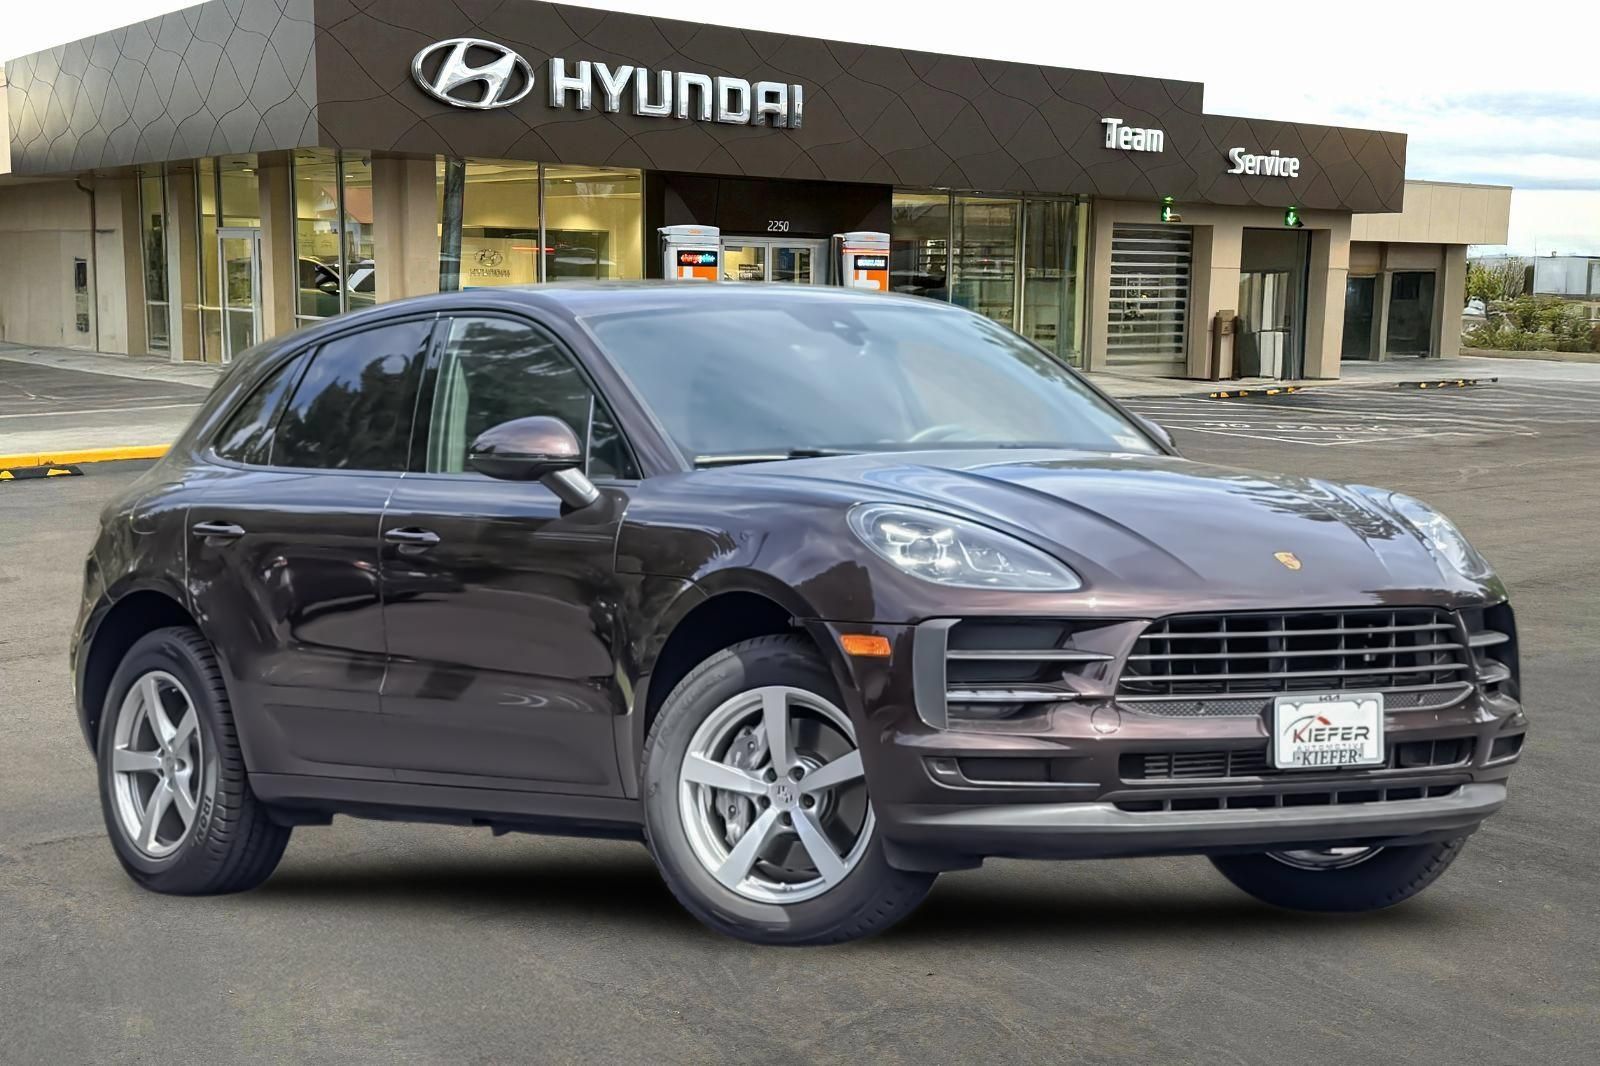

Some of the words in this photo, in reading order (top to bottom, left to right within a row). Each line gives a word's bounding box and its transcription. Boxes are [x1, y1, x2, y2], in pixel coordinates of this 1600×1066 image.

[549, 57, 803, 129] HYUNDAI
[1101, 117, 1164, 153] Team
[1228, 147, 1300, 178] Service
[767, 220, 790, 232] 2250
[1292, 726, 1370, 743] KIEFER
[1302, 749, 1358, 766] KIEFER
